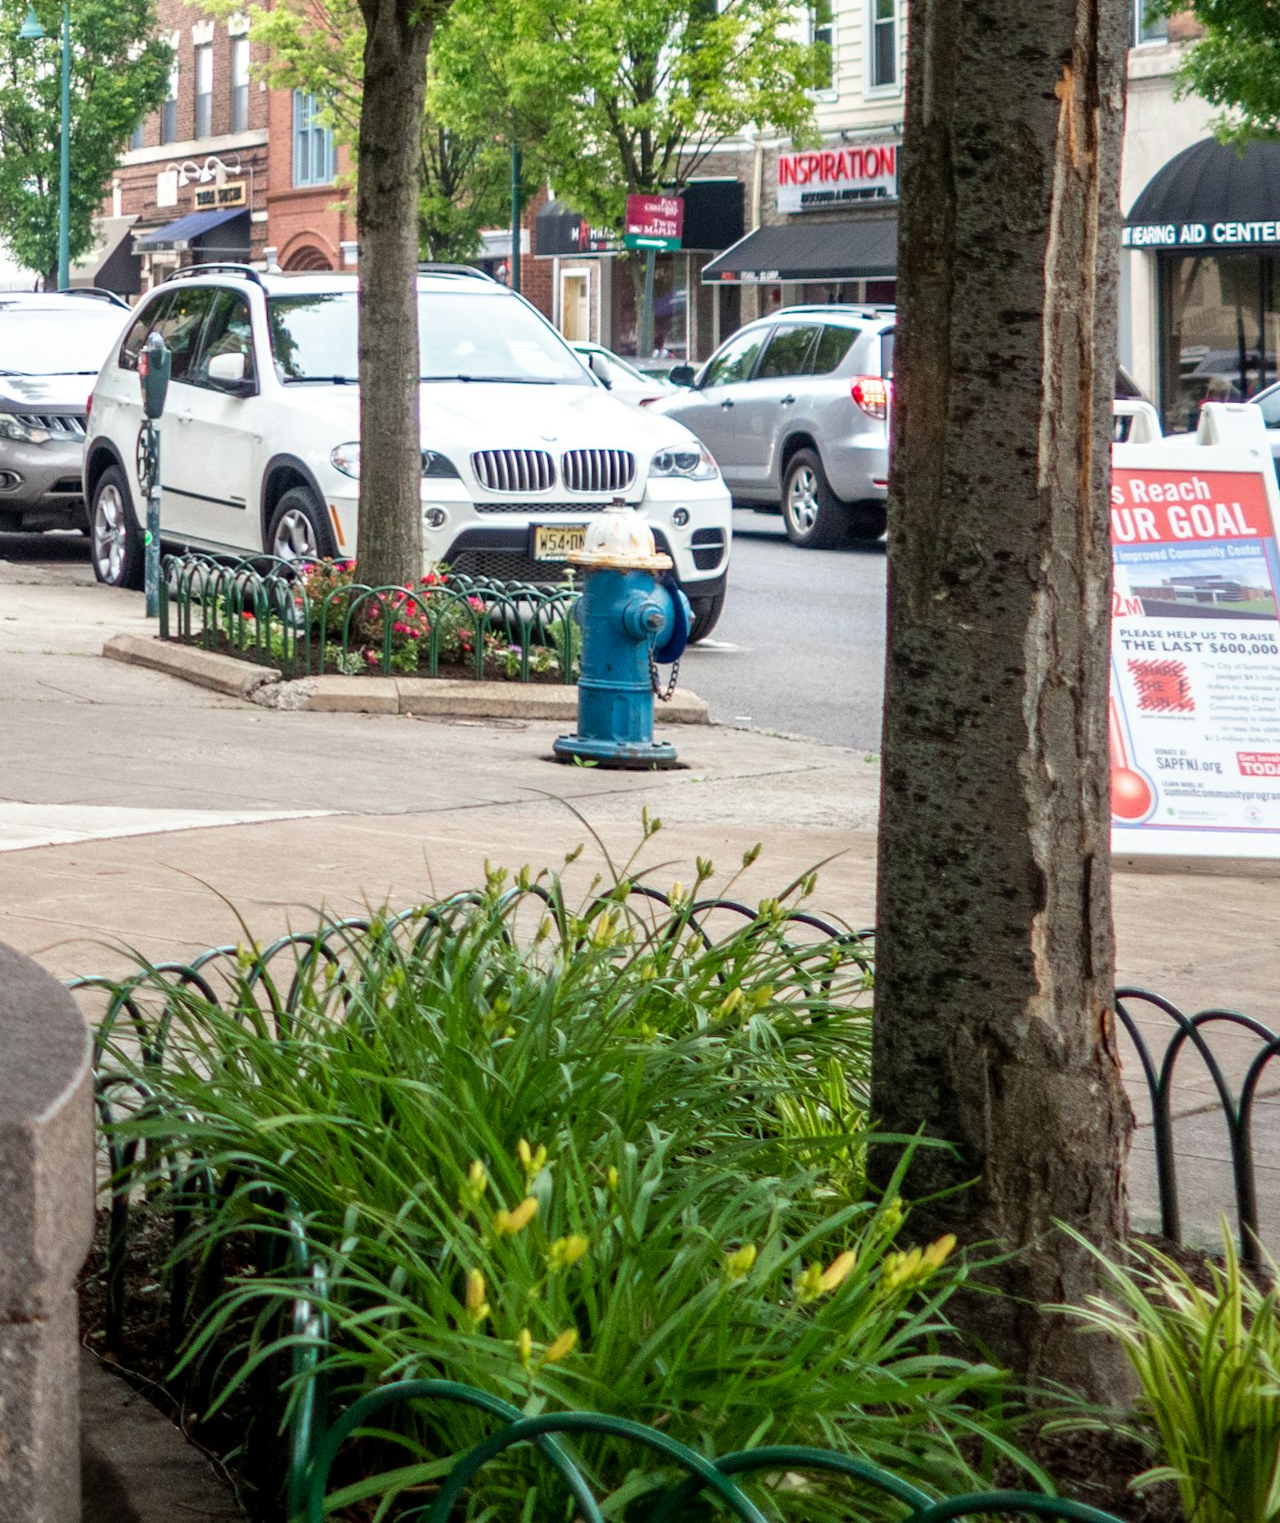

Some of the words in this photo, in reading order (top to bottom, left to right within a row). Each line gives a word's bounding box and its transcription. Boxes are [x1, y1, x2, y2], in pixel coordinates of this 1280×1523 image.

[779, 145, 895, 186] INSPIRATION
[644, 225, 677, 236] MAPLES
[652, 218, 677, 228] TWIN
[1132, 225, 1175, 245] HEARING
[1180, 223, 1206, 243] AID
[1129, 476, 1211, 503] Reach
[1167, 502, 1257, 540] GOAL
[1169, 545, 1225, 561] Community
[1227, 544, 1261, 557] Center
[1120, 629, 1163, 639] PLEASE
[1167, 630, 1198, 639] HELP
[1201, 631, 1217, 640] US
[1220, 632, 1237, 640] TO
[1240, 633, 1276, 642] RAISE
[1121, 639, 1157, 651] THE
[1161, 641, 1203, 653] LAST
[1209, 642, 1279, 656] $600,000
[1134, 664, 1182, 678] SHARE
[1138, 680, 1166, 692] THE
[1156, 756, 1223, 774] SAPFNJ.org
[1239, 753, 1255, 762] Get
